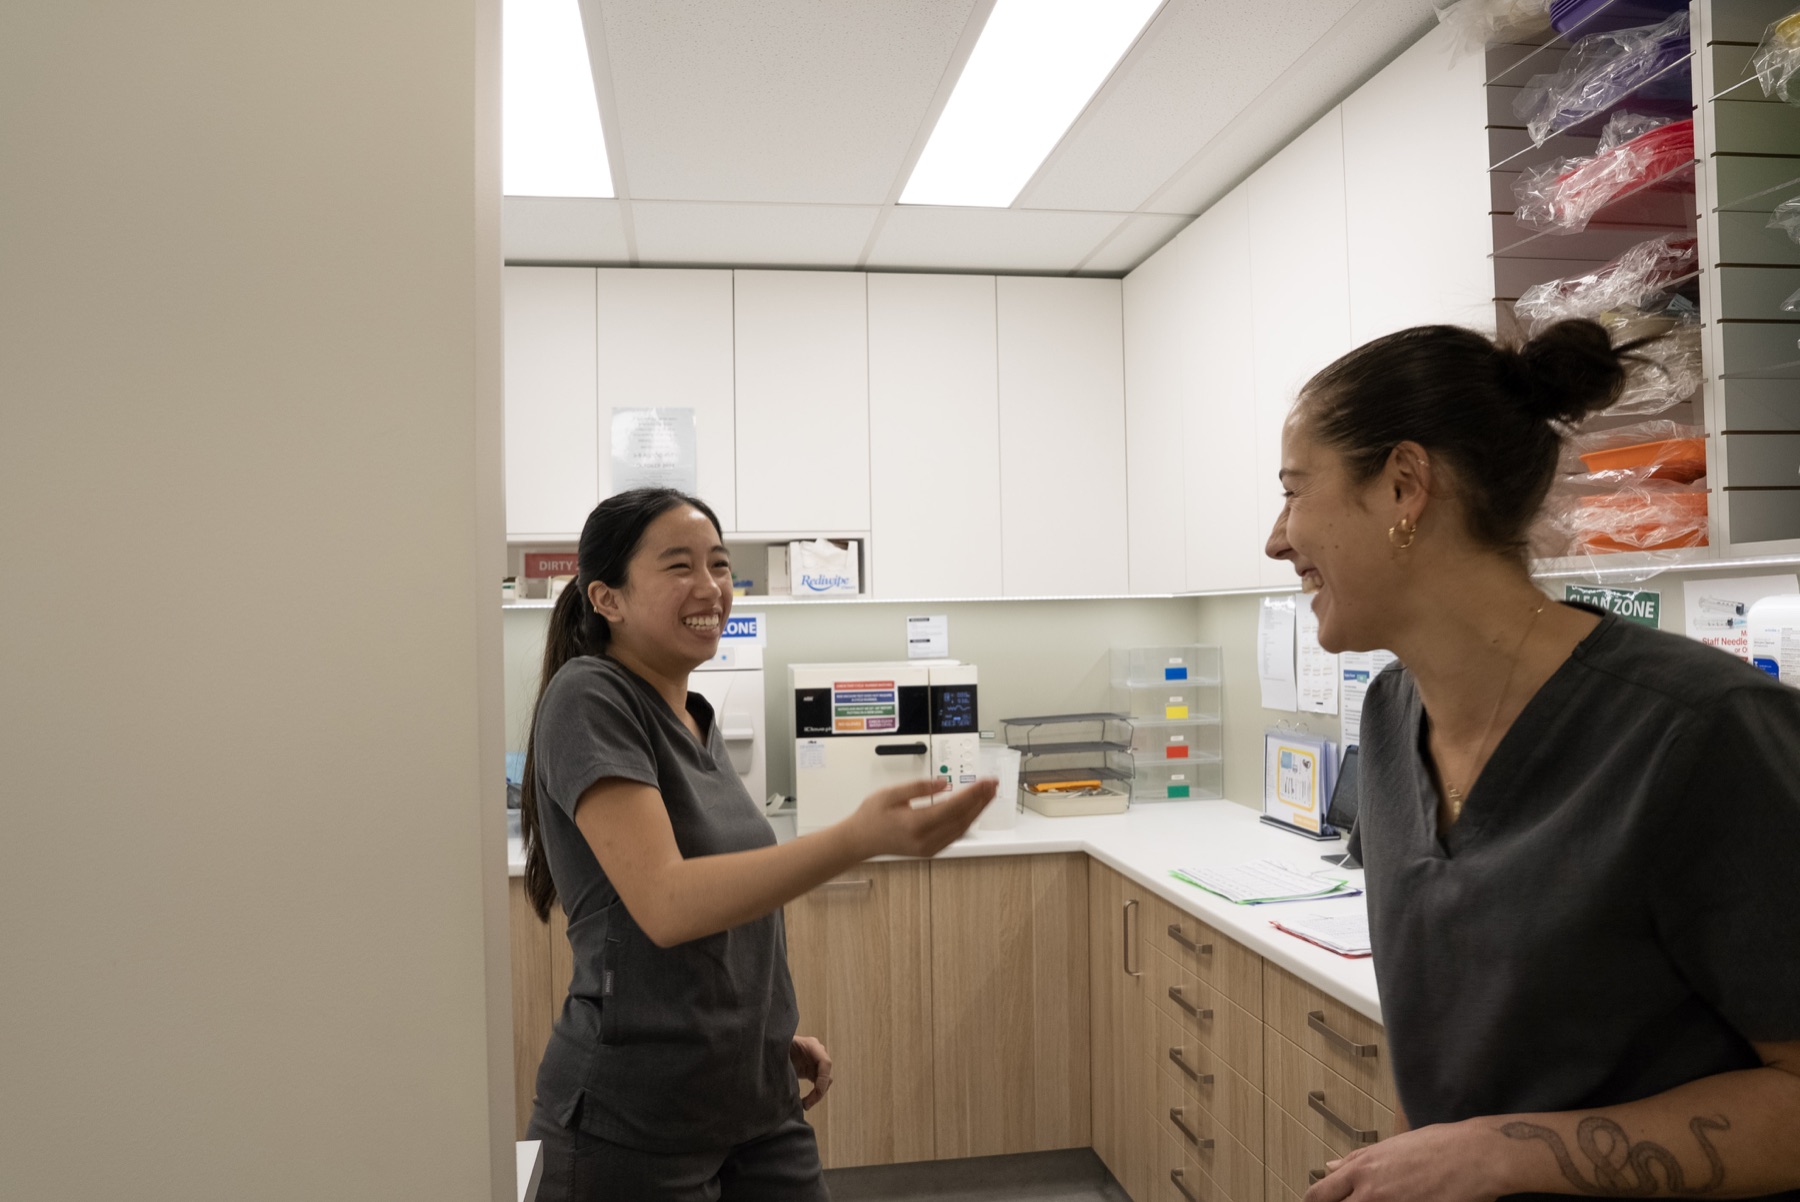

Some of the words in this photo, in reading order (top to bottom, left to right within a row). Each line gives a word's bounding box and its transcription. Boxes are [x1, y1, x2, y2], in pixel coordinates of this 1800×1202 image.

[540, 561, 573, 571] DIRTY
[801, 574, 850, 588] Rediwipe
[1613, 598, 1655, 619] ZONE
[1702, 638, 1719, 646] Staff
[1722, 638, 1748, 646] Needle
